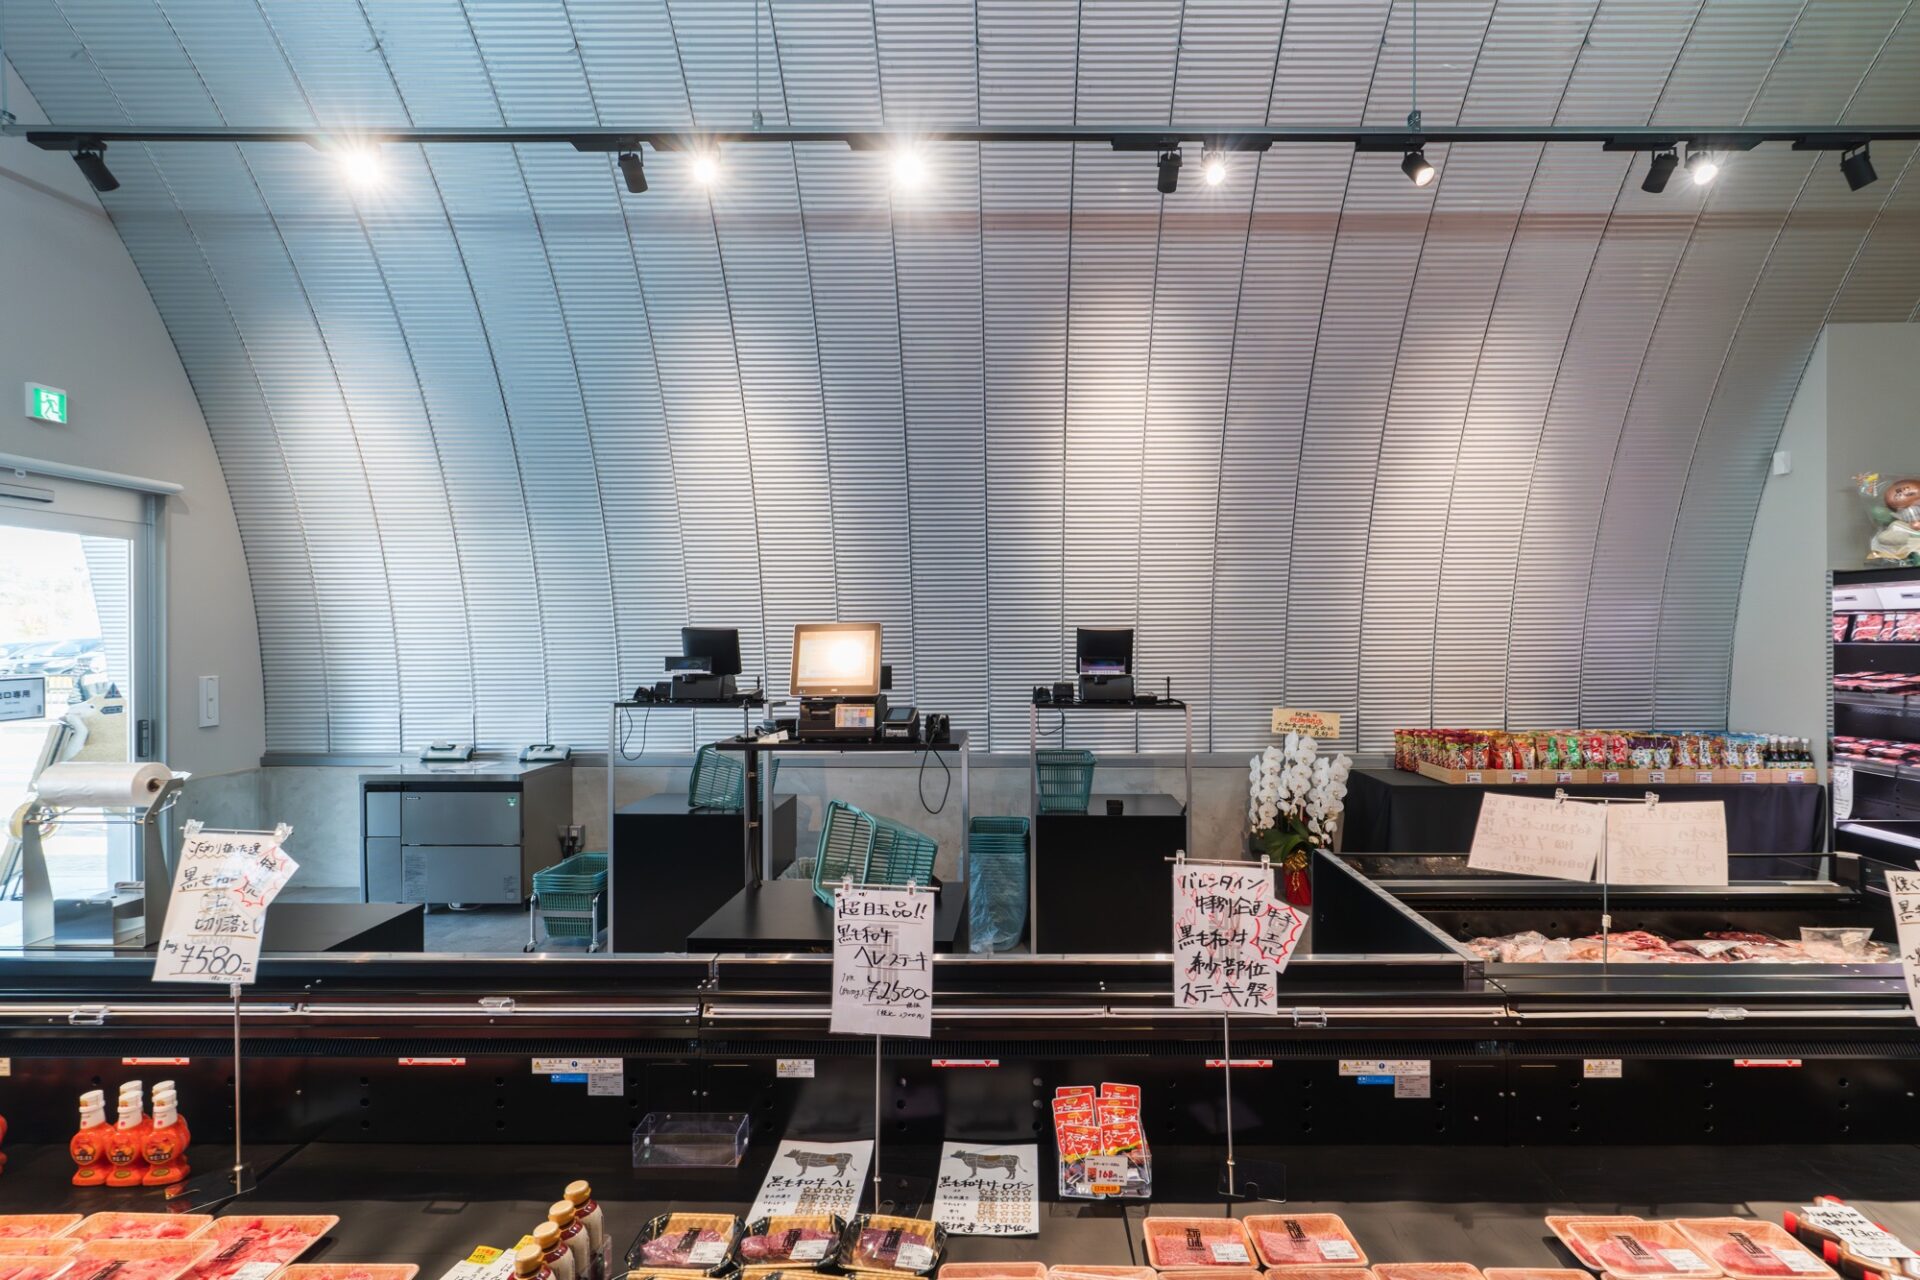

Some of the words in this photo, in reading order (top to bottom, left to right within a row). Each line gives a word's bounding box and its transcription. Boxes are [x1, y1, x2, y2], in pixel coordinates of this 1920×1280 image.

[1181, 872, 1265, 891] バレンタイン
[837, 924, 893, 944] 黒毛和牛
[1177, 925, 1249, 950] 黒毛和牛
[1180, 982, 1268, 1008] ステーキ祭
